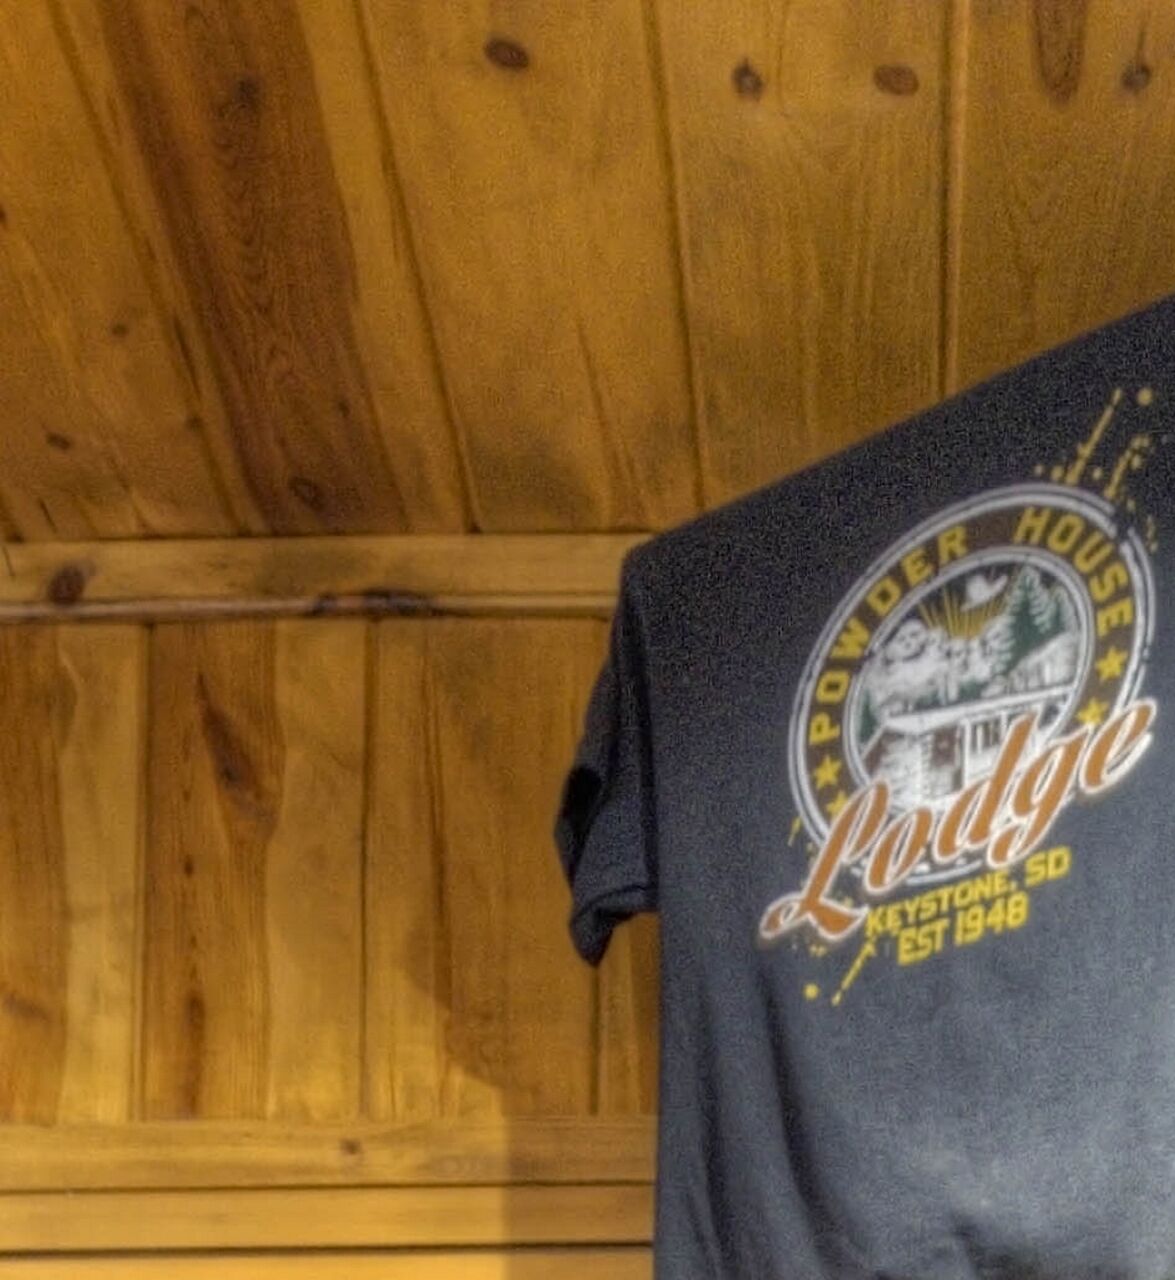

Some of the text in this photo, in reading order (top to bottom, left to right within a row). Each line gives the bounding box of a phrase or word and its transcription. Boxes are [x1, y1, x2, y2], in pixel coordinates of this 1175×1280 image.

[807, 506, 1134, 745] POWDER HOUSE
[759, 698, 1158, 942] Lodge
[864, 846, 1072, 938] KEYSTONE, SD
[898, 890, 1029, 966] EST 1948
